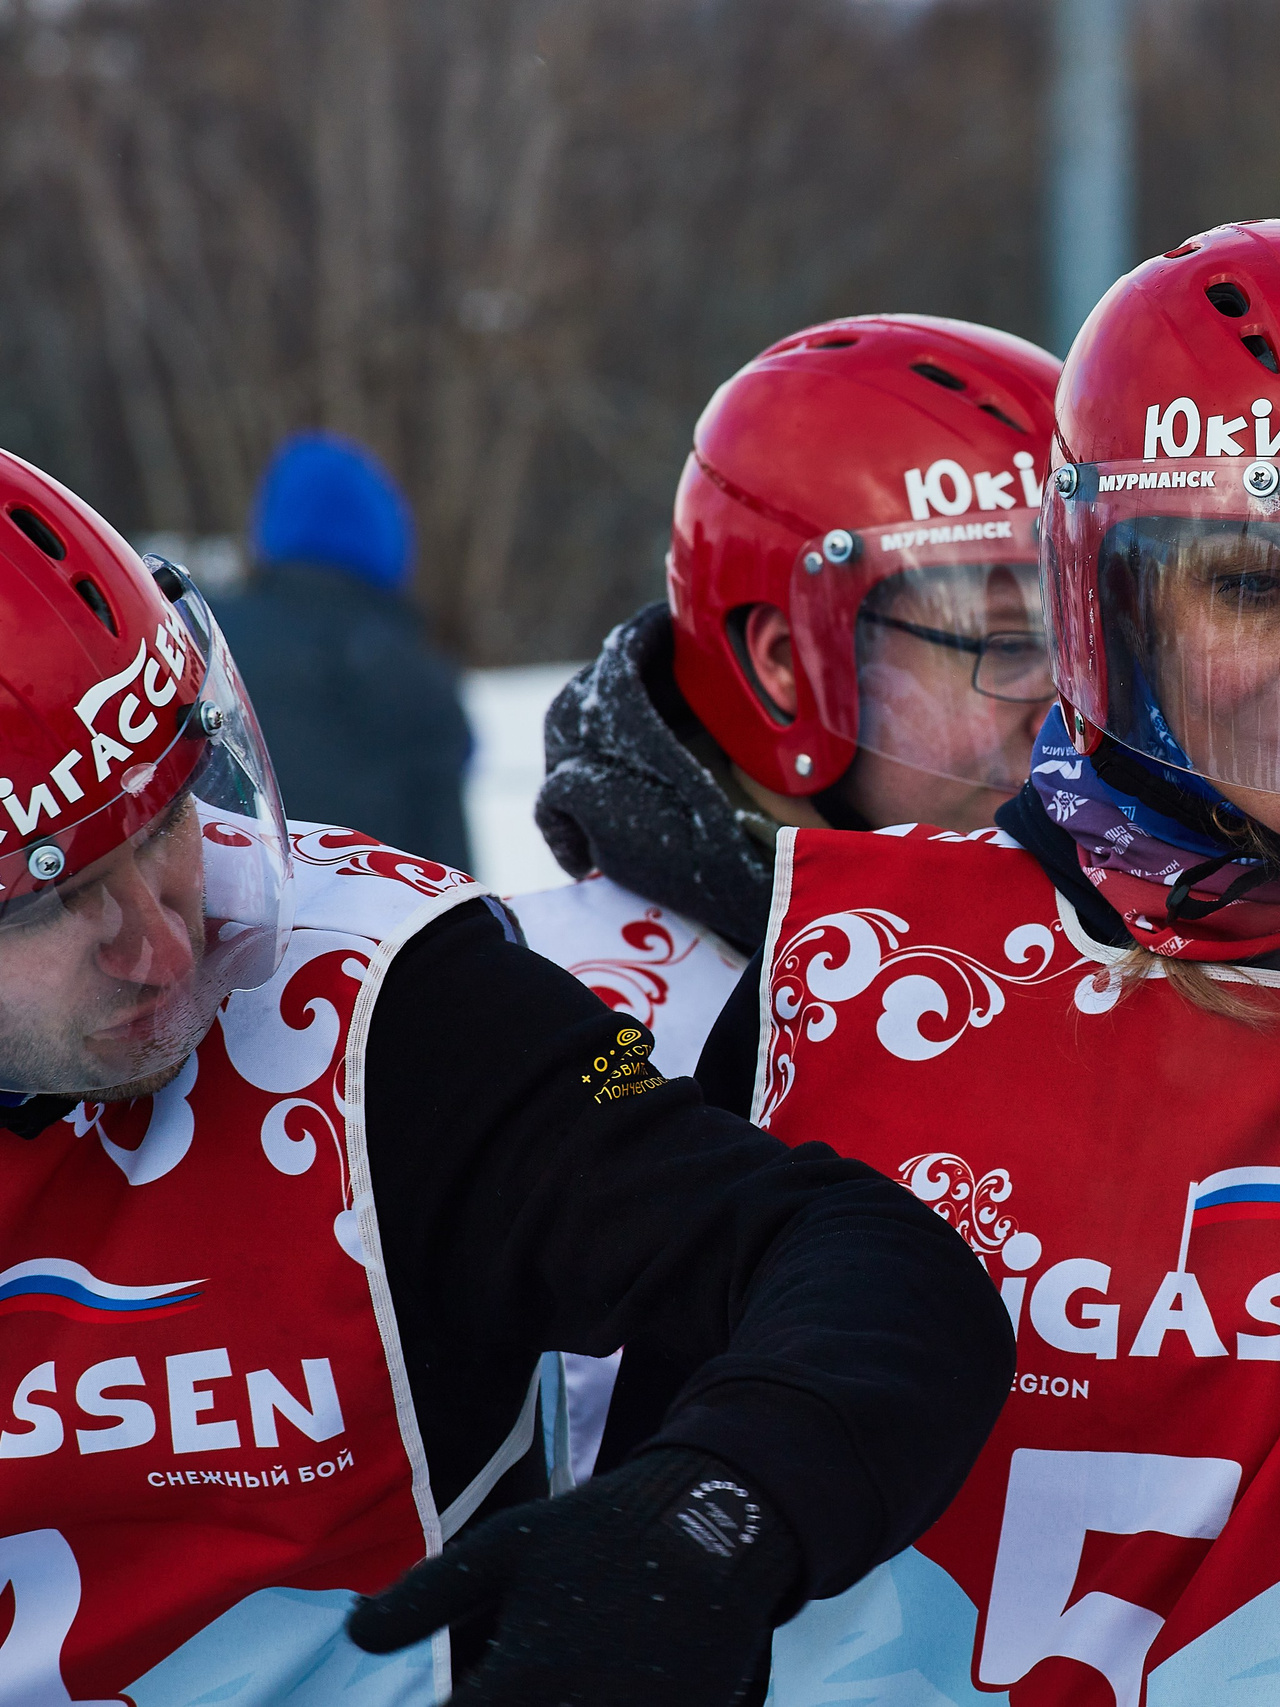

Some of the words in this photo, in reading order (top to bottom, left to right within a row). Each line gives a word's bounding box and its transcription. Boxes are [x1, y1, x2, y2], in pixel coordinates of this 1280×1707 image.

[1098, 470, 1216, 493] МУРМАНСК
[880, 520, 1012, 552] МУРМАНСК
[147, 1462, 291, 1489] СНЕЖНЫЙ
[300, 1447, 356, 1484] БОЙ
[978, 1448, 1243, 1707] 5
